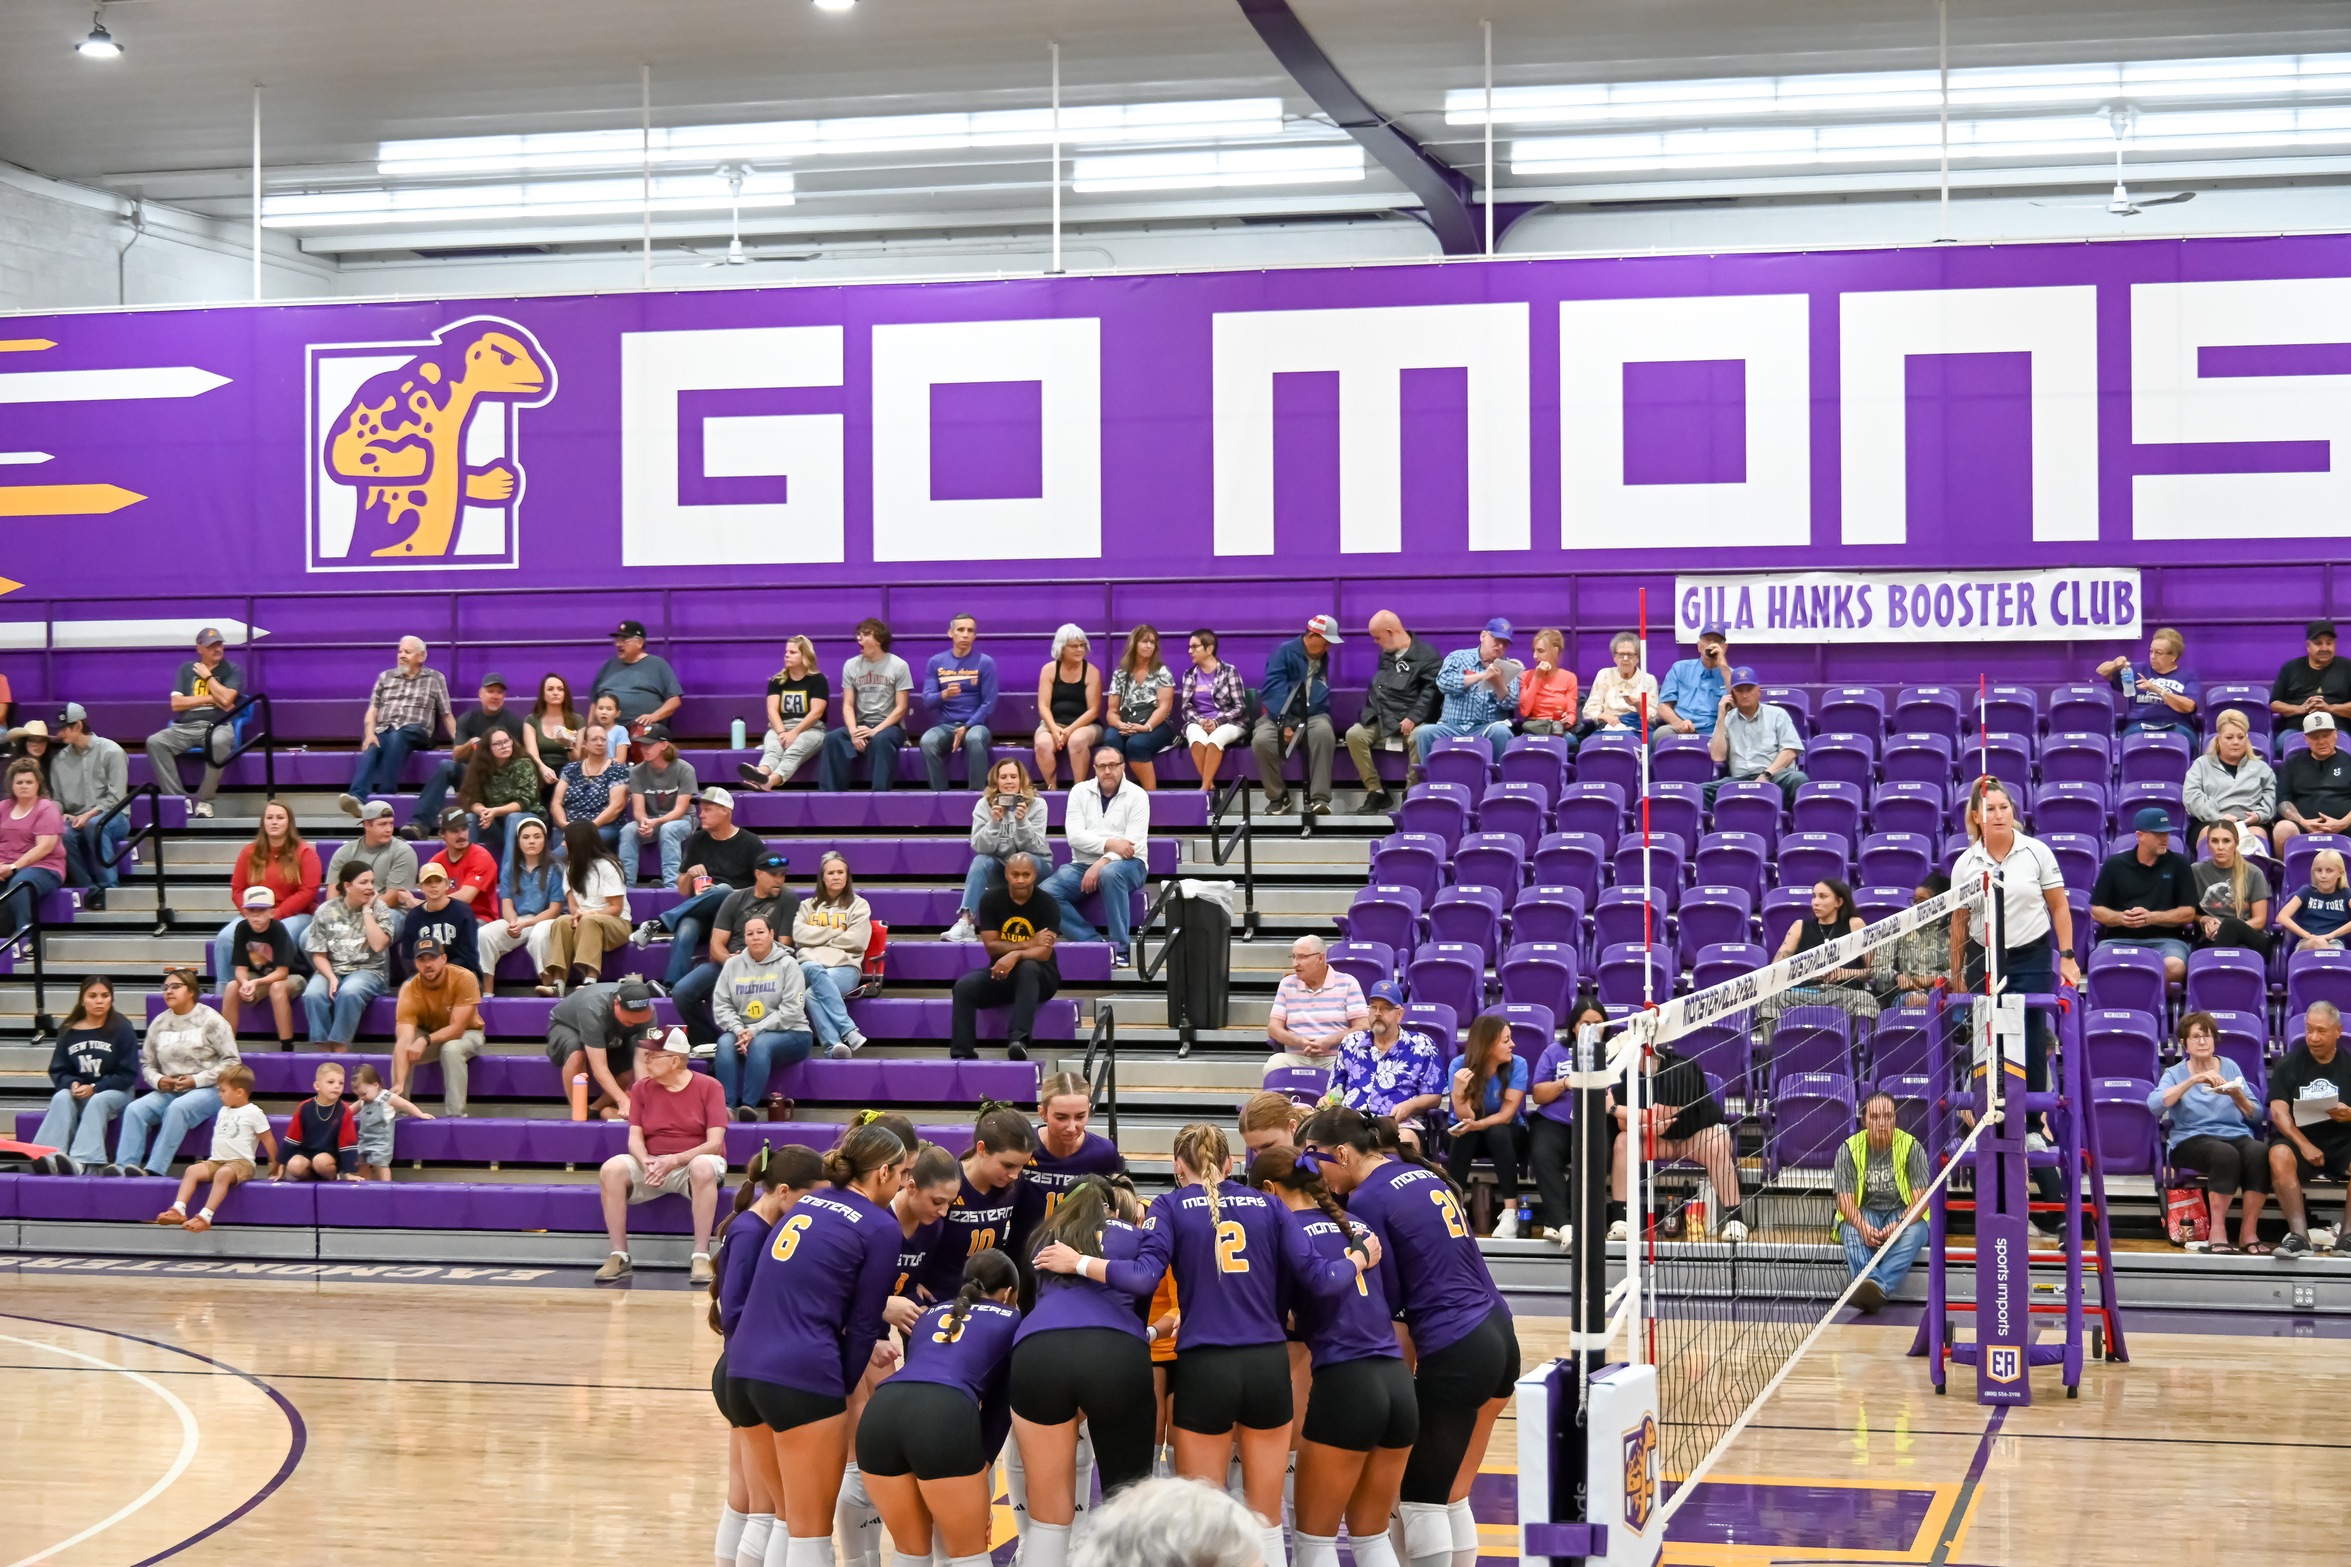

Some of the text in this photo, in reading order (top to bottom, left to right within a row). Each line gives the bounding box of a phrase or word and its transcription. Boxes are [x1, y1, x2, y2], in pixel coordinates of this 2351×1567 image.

[621, 316, 1101, 567] GO
[1682, 580, 2136, 631] GILA HANKS BOOSTER CLUB
[784, 693, 804, 712] EA
[2308, 896, 2345, 912] NEW YORK
[736, 982, 776, 996] VOLLEYBALL
[67, 1040, 112, 1055] NEW YORK
[78, 1054, 103, 1078] NY
[1390, 1169, 1439, 1190] MONSTE
[798, 1195, 863, 1223] ONSTERS
[1183, 1197, 1267, 1210] MOSTERS
[771, 1214, 813, 1262] 6
[967, 1228, 996, 1257] 10
[1218, 1220, 1249, 1273] 2
[1994, 1237, 2009, 1337] sports imports
[1992, 1350, 2016, 1379] EA
